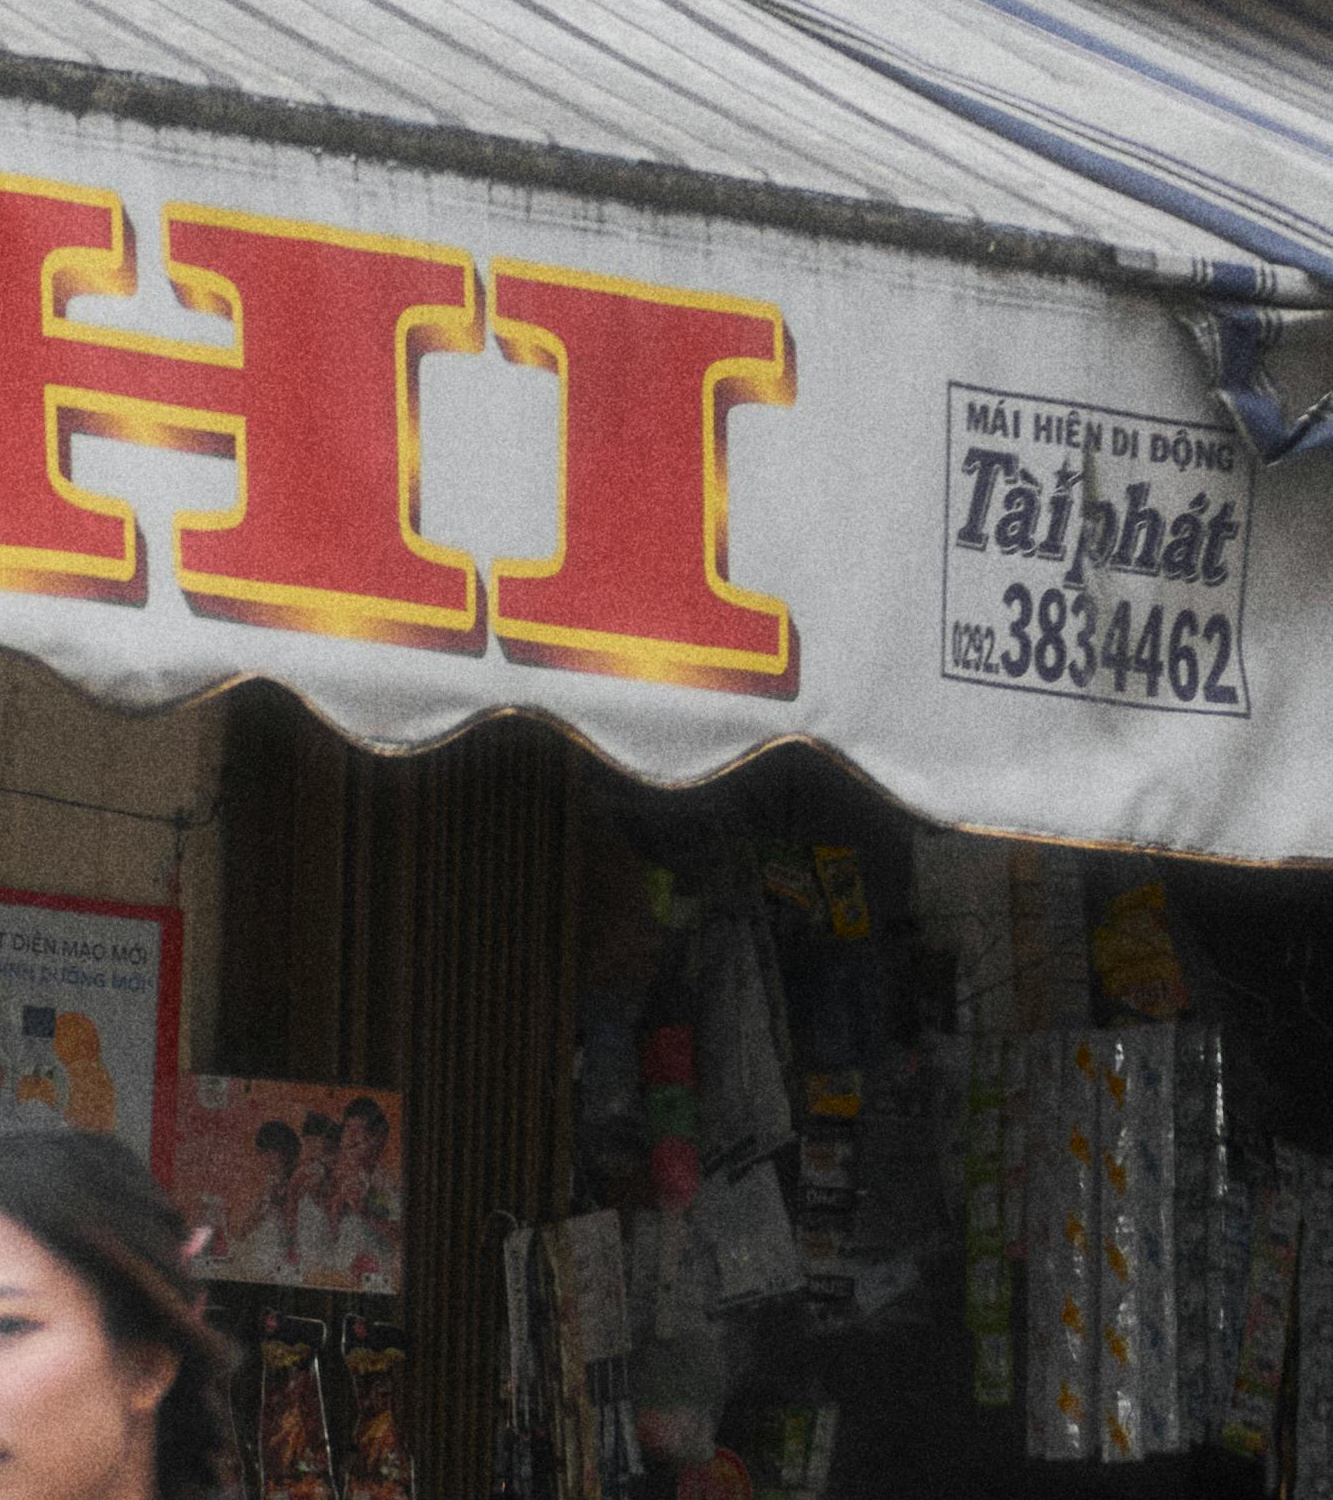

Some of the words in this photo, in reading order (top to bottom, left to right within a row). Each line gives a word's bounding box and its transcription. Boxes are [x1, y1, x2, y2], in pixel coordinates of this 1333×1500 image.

[966, 399, 1022, 439] MÁI
[1034, 411, 1103, 452] HIÊN
[1112, 426, 1139, 459] DI
[1150, 430, 1234, 473] ĐỘNG
